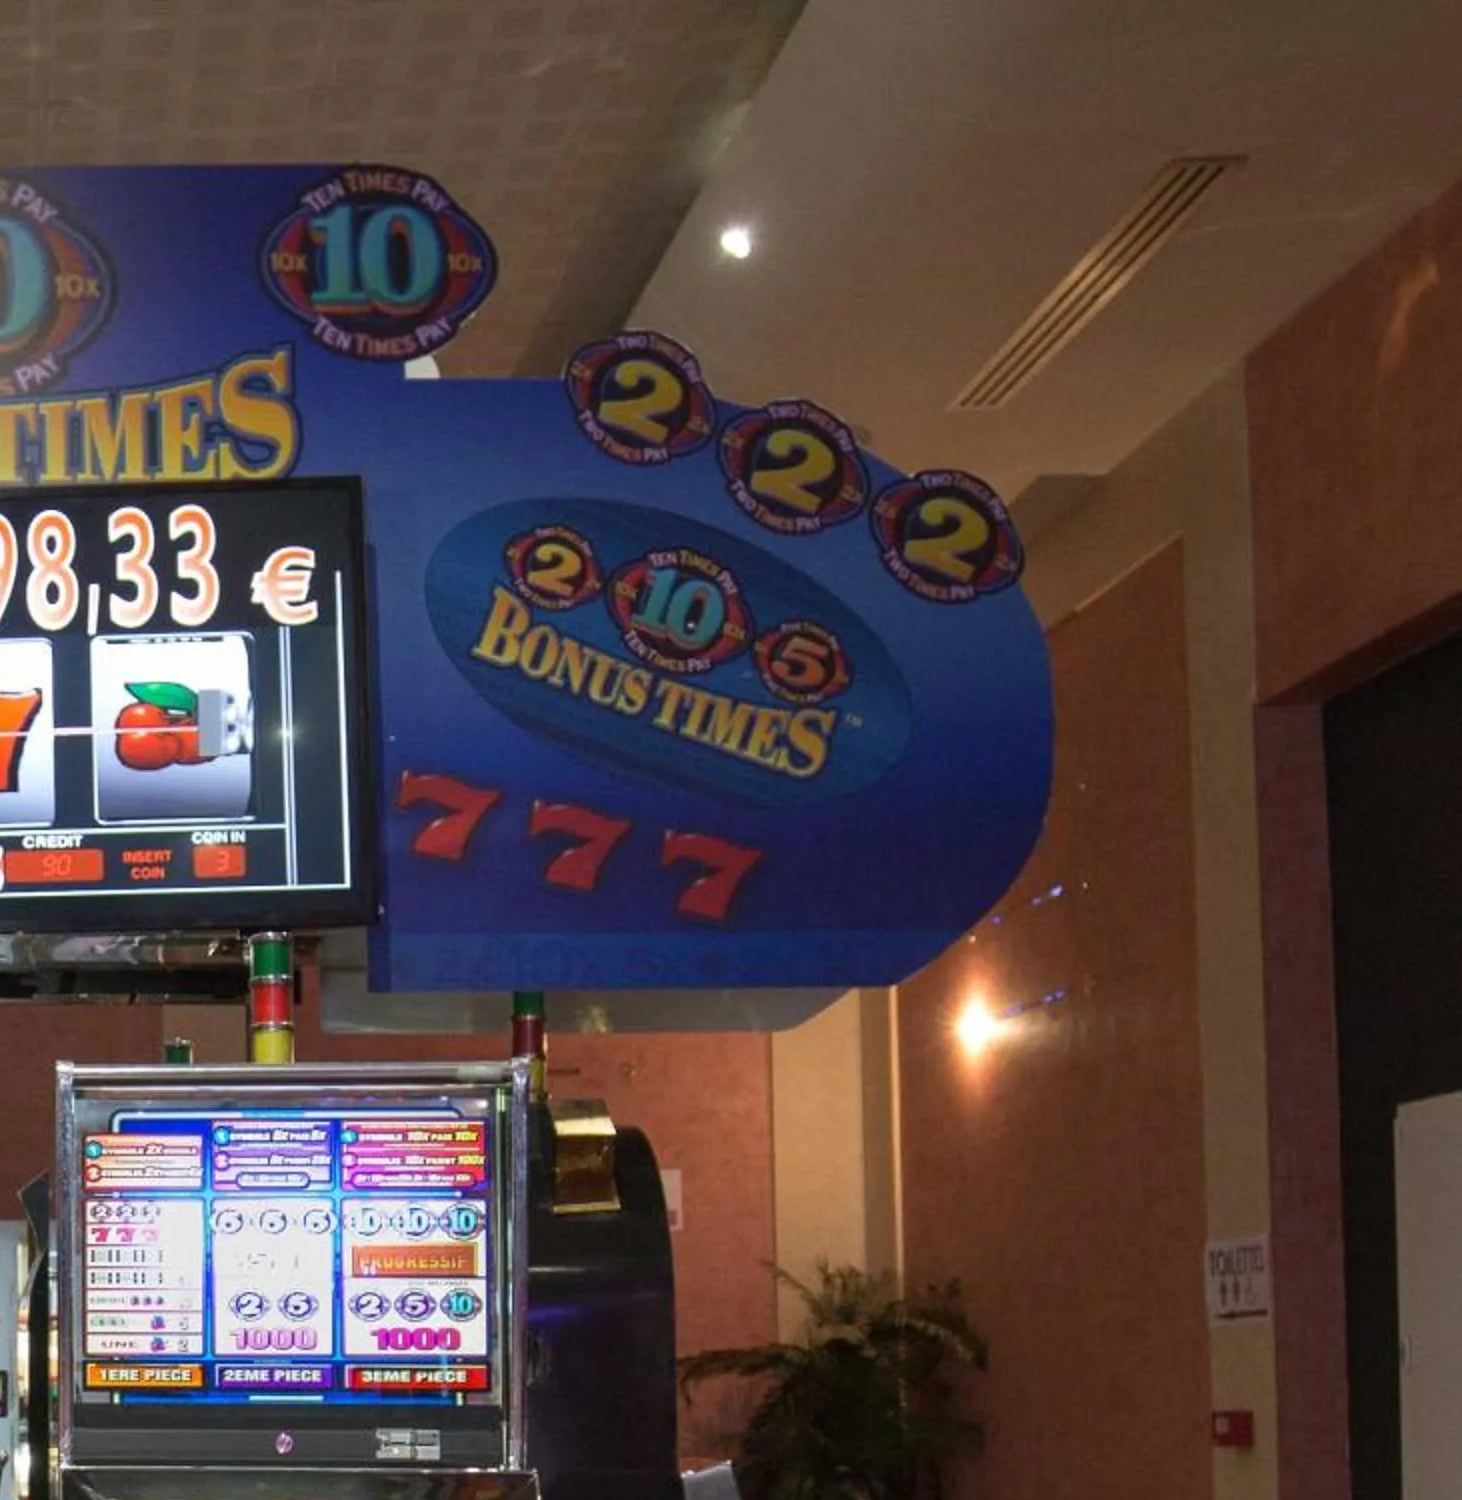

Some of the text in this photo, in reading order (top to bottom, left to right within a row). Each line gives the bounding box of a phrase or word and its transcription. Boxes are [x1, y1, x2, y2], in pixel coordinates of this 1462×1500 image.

[11, 183, 58, 224] PAY
[302, 170, 450, 211] TEN TIMES PAY
[308, 203, 442, 303] 10
[313, 316, 451, 357] TEN TIMES PAY
[15, 351, 60, 392] PAY
[598, 359, 684, 445] 2
[750, 429, 836, 514] 2
[903, 497, 990, 583] 2
[526, 543, 583, 597] 2
[632, 568, 726, 645] 10
[472, 585, 836, 778] BONUS TIMES
[770, 636, 829, 689] 5
[22, 834, 83, 849] CREDIT
[191, 831, 246, 844] COIN IN
[396, 768, 763, 920] 7 7 7
[130, 866, 166, 880] COIN
[229, 1327, 318, 1351] 1000
[370, 1327, 462, 1351] 1000
[99, 1369, 192, 1382] 1ERE PIECE
[222, 1369, 323, 1382] 2EME PIECE
[361, 1370, 467, 1383] 3EME PIECE
